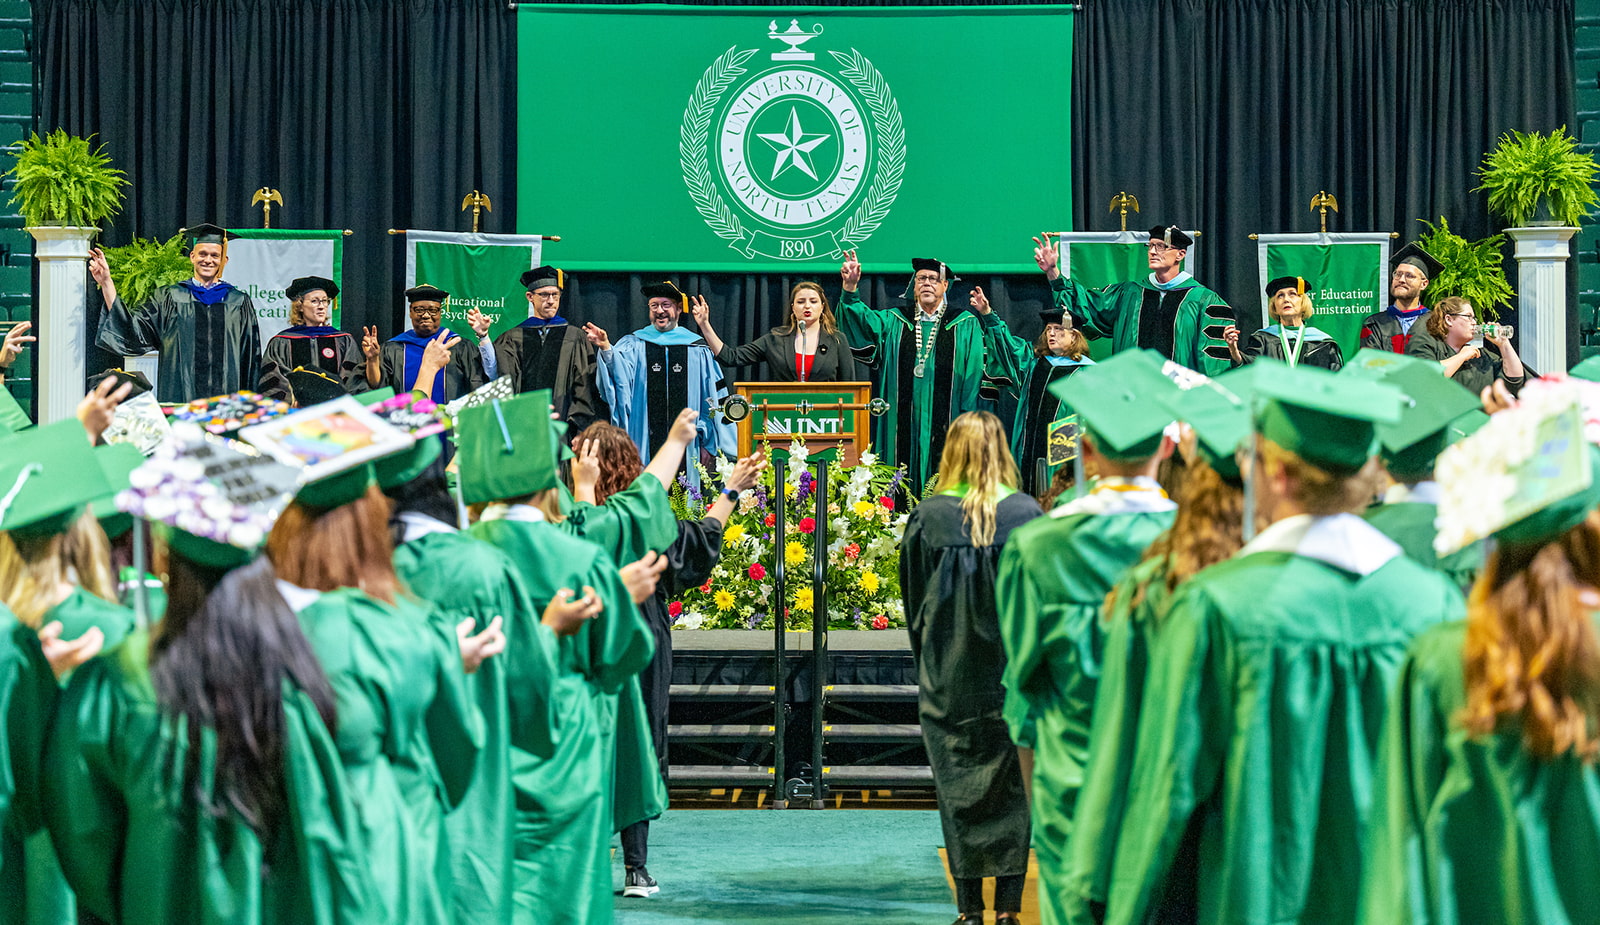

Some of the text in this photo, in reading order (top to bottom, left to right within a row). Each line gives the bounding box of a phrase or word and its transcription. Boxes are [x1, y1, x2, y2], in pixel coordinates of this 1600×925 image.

[726, 75, 862, 136] UNIVERSITY OF
[727, 161, 859, 220] NORTH TEXAS
[779, 240, 815, 258] 1890
[441, 295, 505, 308] ducational
[1320, 288, 1373, 300] Education
